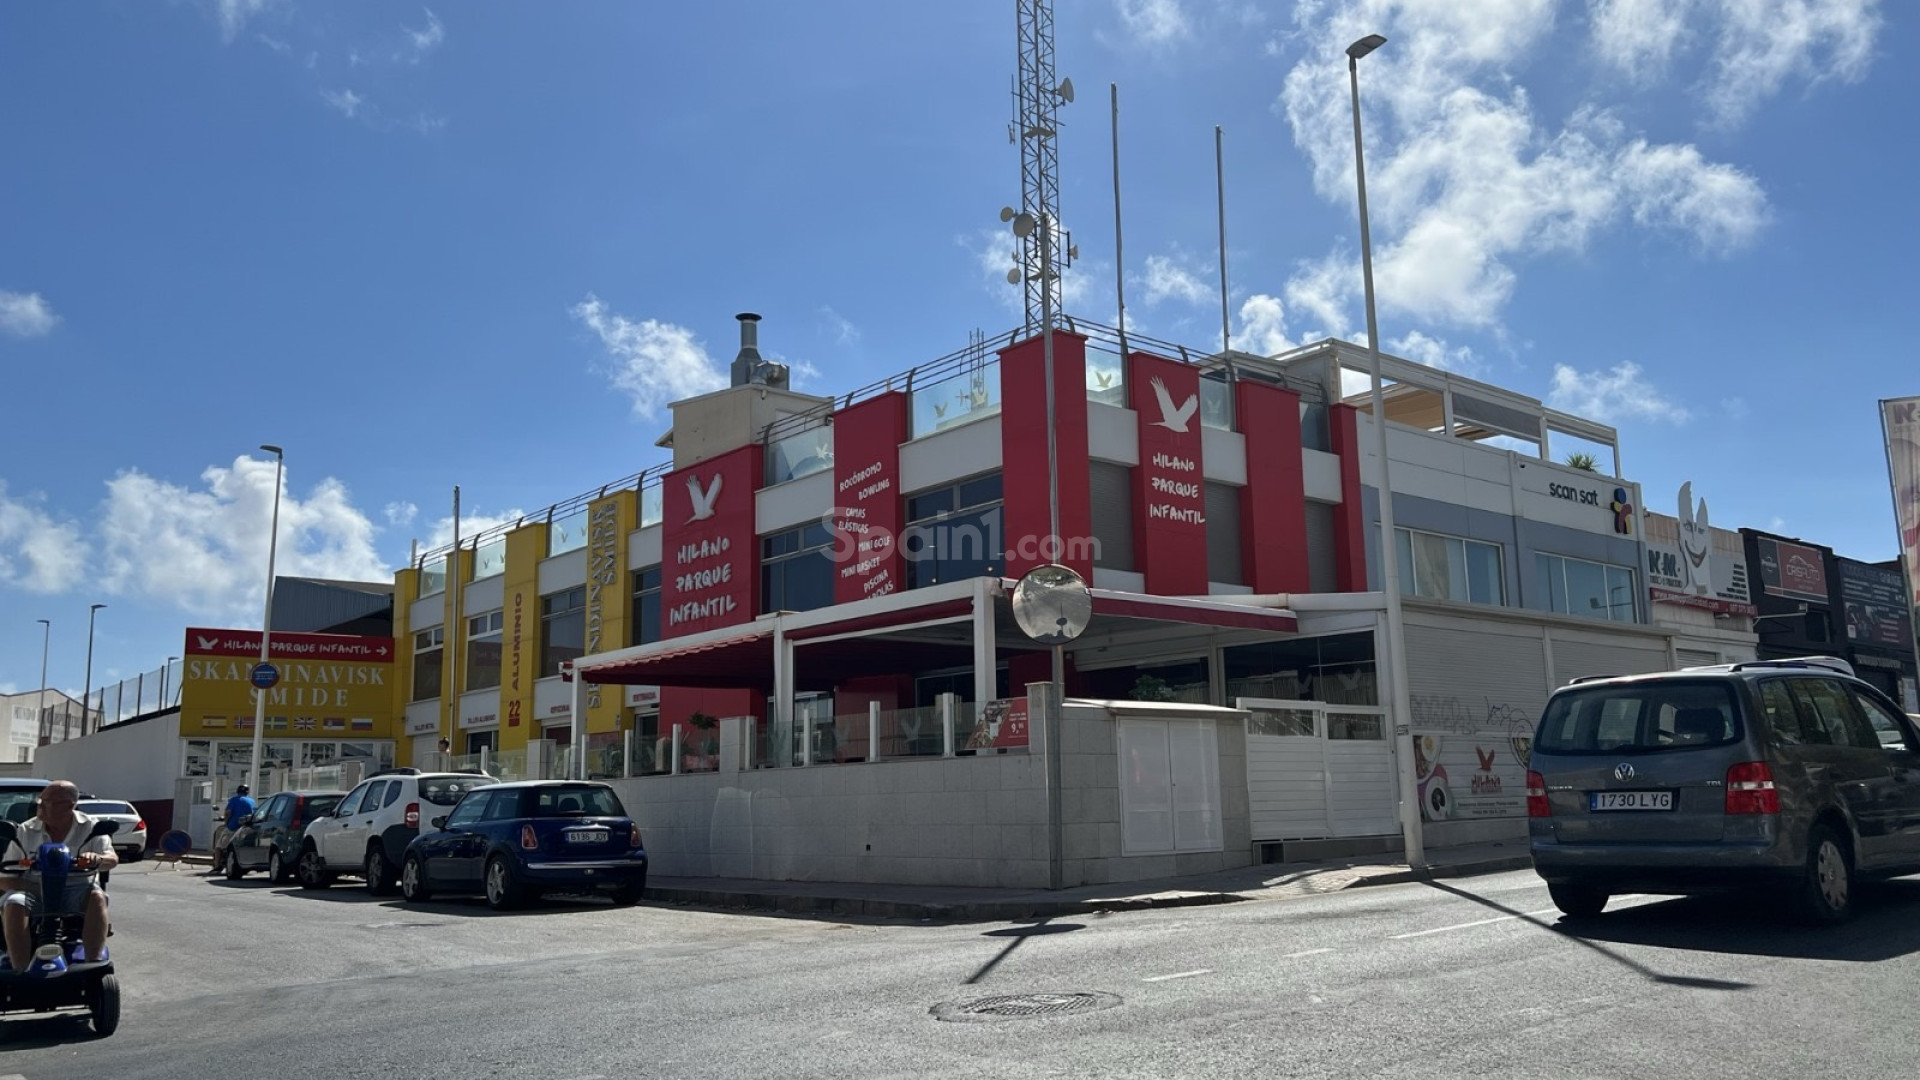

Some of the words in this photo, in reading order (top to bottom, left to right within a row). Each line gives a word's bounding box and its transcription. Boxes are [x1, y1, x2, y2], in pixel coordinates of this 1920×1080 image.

[1153, 452, 1195, 472] HILANO
[840, 461, 882, 493] ROCÓDROMO
[1151, 477, 1199, 498] PARQUE
[858, 478, 890, 500] BOWLING
[1549, 482, 1578, 502] scan
[1579, 489, 1599, 506] sat
[1149, 503, 1206, 525] INFANTIL
[678, 536, 730, 564] HILANO
[858, 541, 873, 552] MINI
[874, 535, 890, 548] GOLF
[676, 563, 731, 592] PARQUE
[841, 564, 856, 578] MINI
[864, 569, 888, 593] PISCINA
[669, 594, 737, 626] INFANTIL
[224, 641, 264, 651] HILAN
[271, 642, 316, 653] PARQUE
[320, 644, 371, 654] INFANTIL
[512, 592, 522, 691] ALUMINIO
[189, 660, 384, 685] SKAINAVISK
[249, 686, 348, 707] SMIDE
[508, 700, 520, 717] 22
[1601, 794, 1635, 807] 1730
[1640, 794, 1669, 807] LYG
